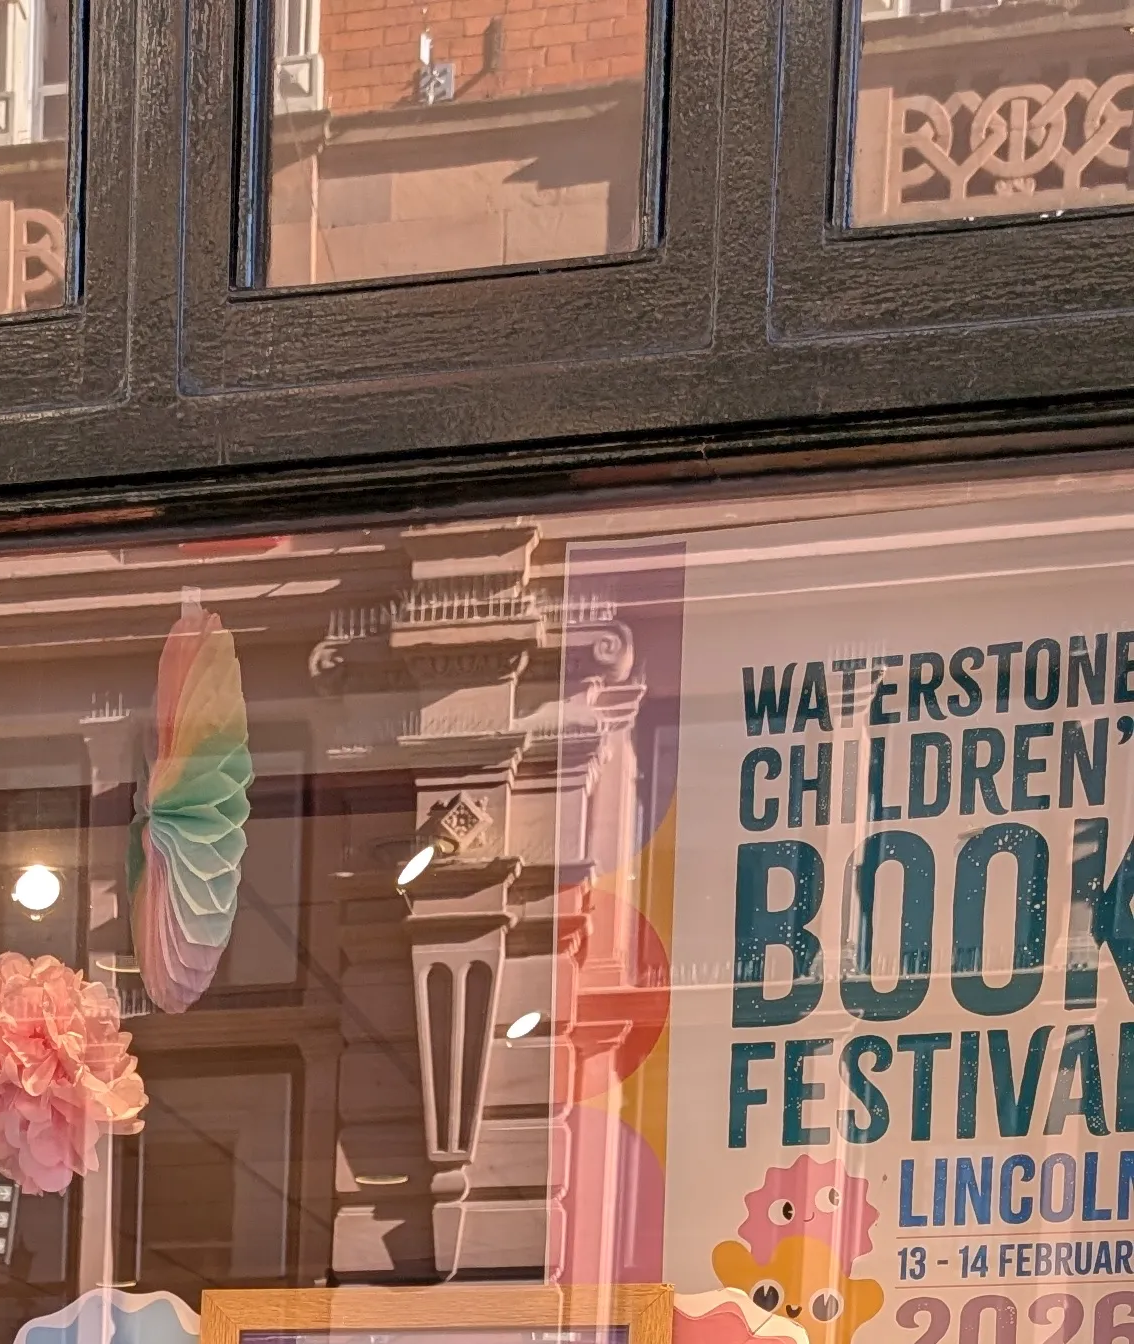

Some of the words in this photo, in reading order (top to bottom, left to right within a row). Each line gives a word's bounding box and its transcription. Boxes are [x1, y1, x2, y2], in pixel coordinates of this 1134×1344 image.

[732, 817, 1134, 1028] BOOK
[898, 1247, 925, 1279] 13
[959, 1245, 988, 1277] 14
